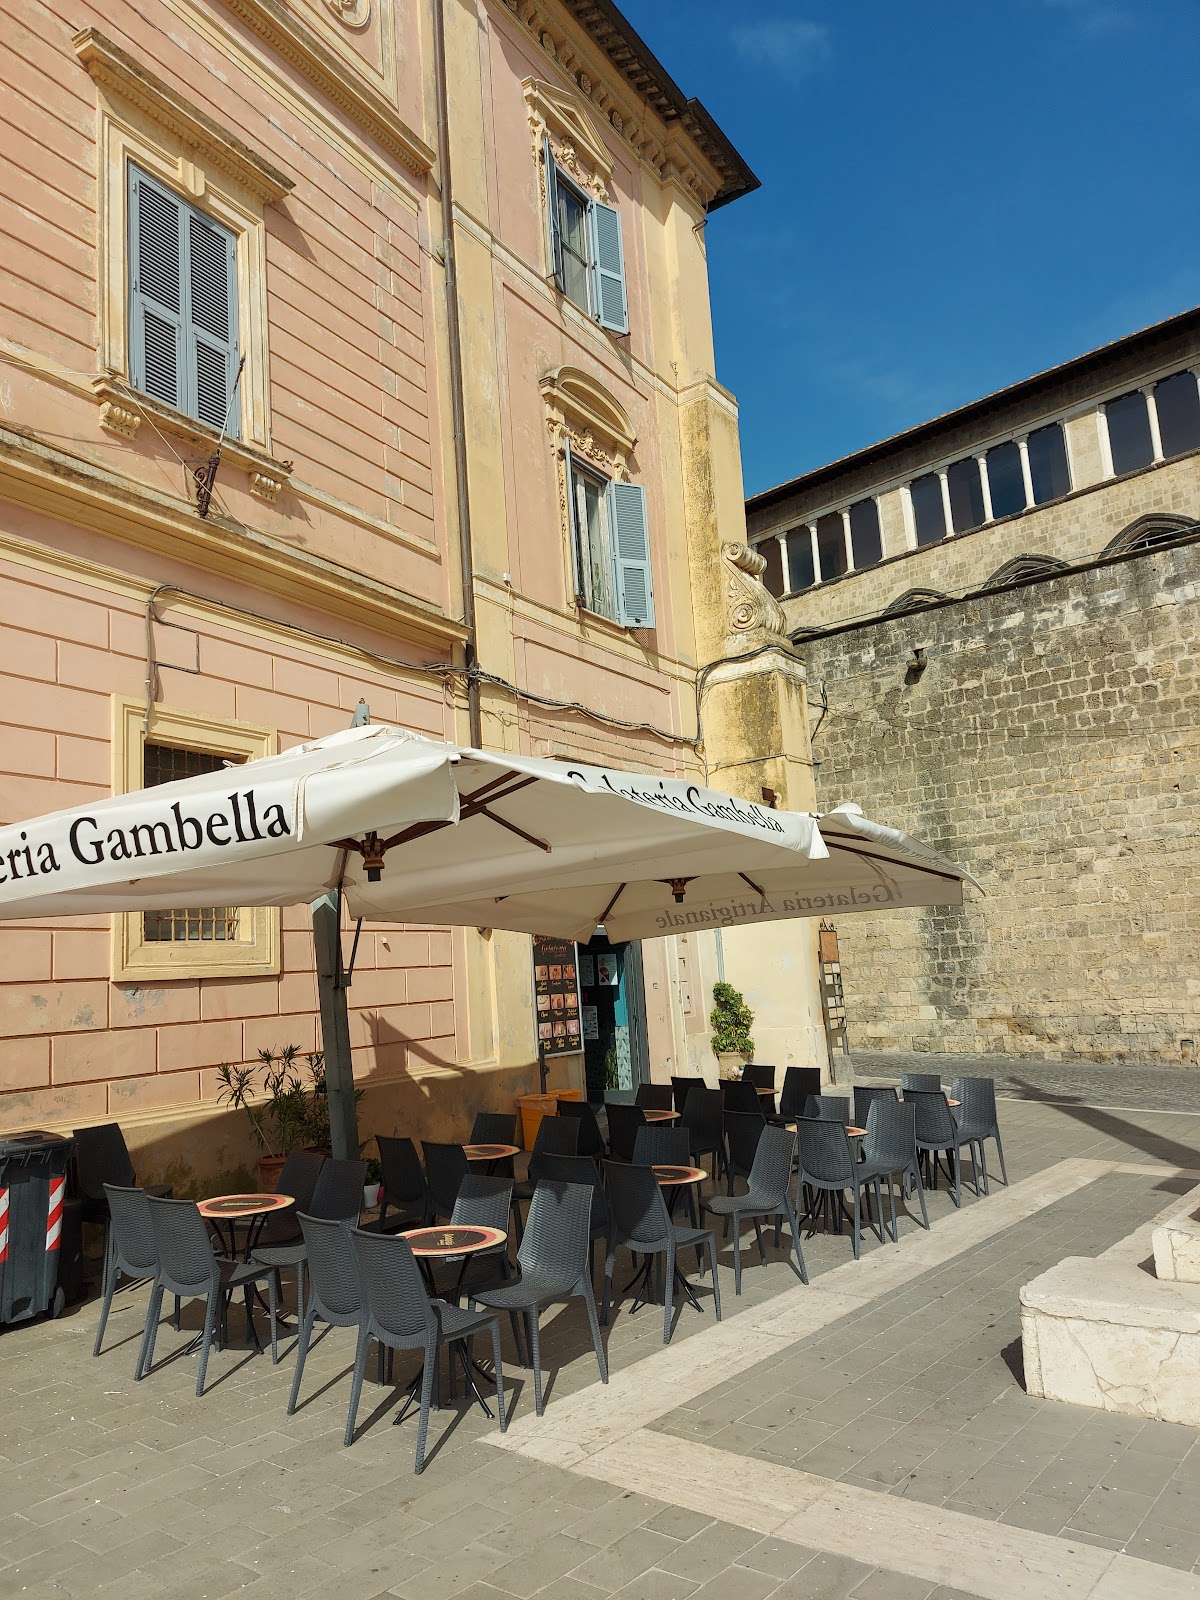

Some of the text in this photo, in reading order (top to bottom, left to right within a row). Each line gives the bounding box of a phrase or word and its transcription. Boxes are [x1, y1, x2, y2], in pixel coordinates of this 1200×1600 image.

[69, 789, 291, 865] Gambella
[567, 770, 785, 833] lateria Gambella
